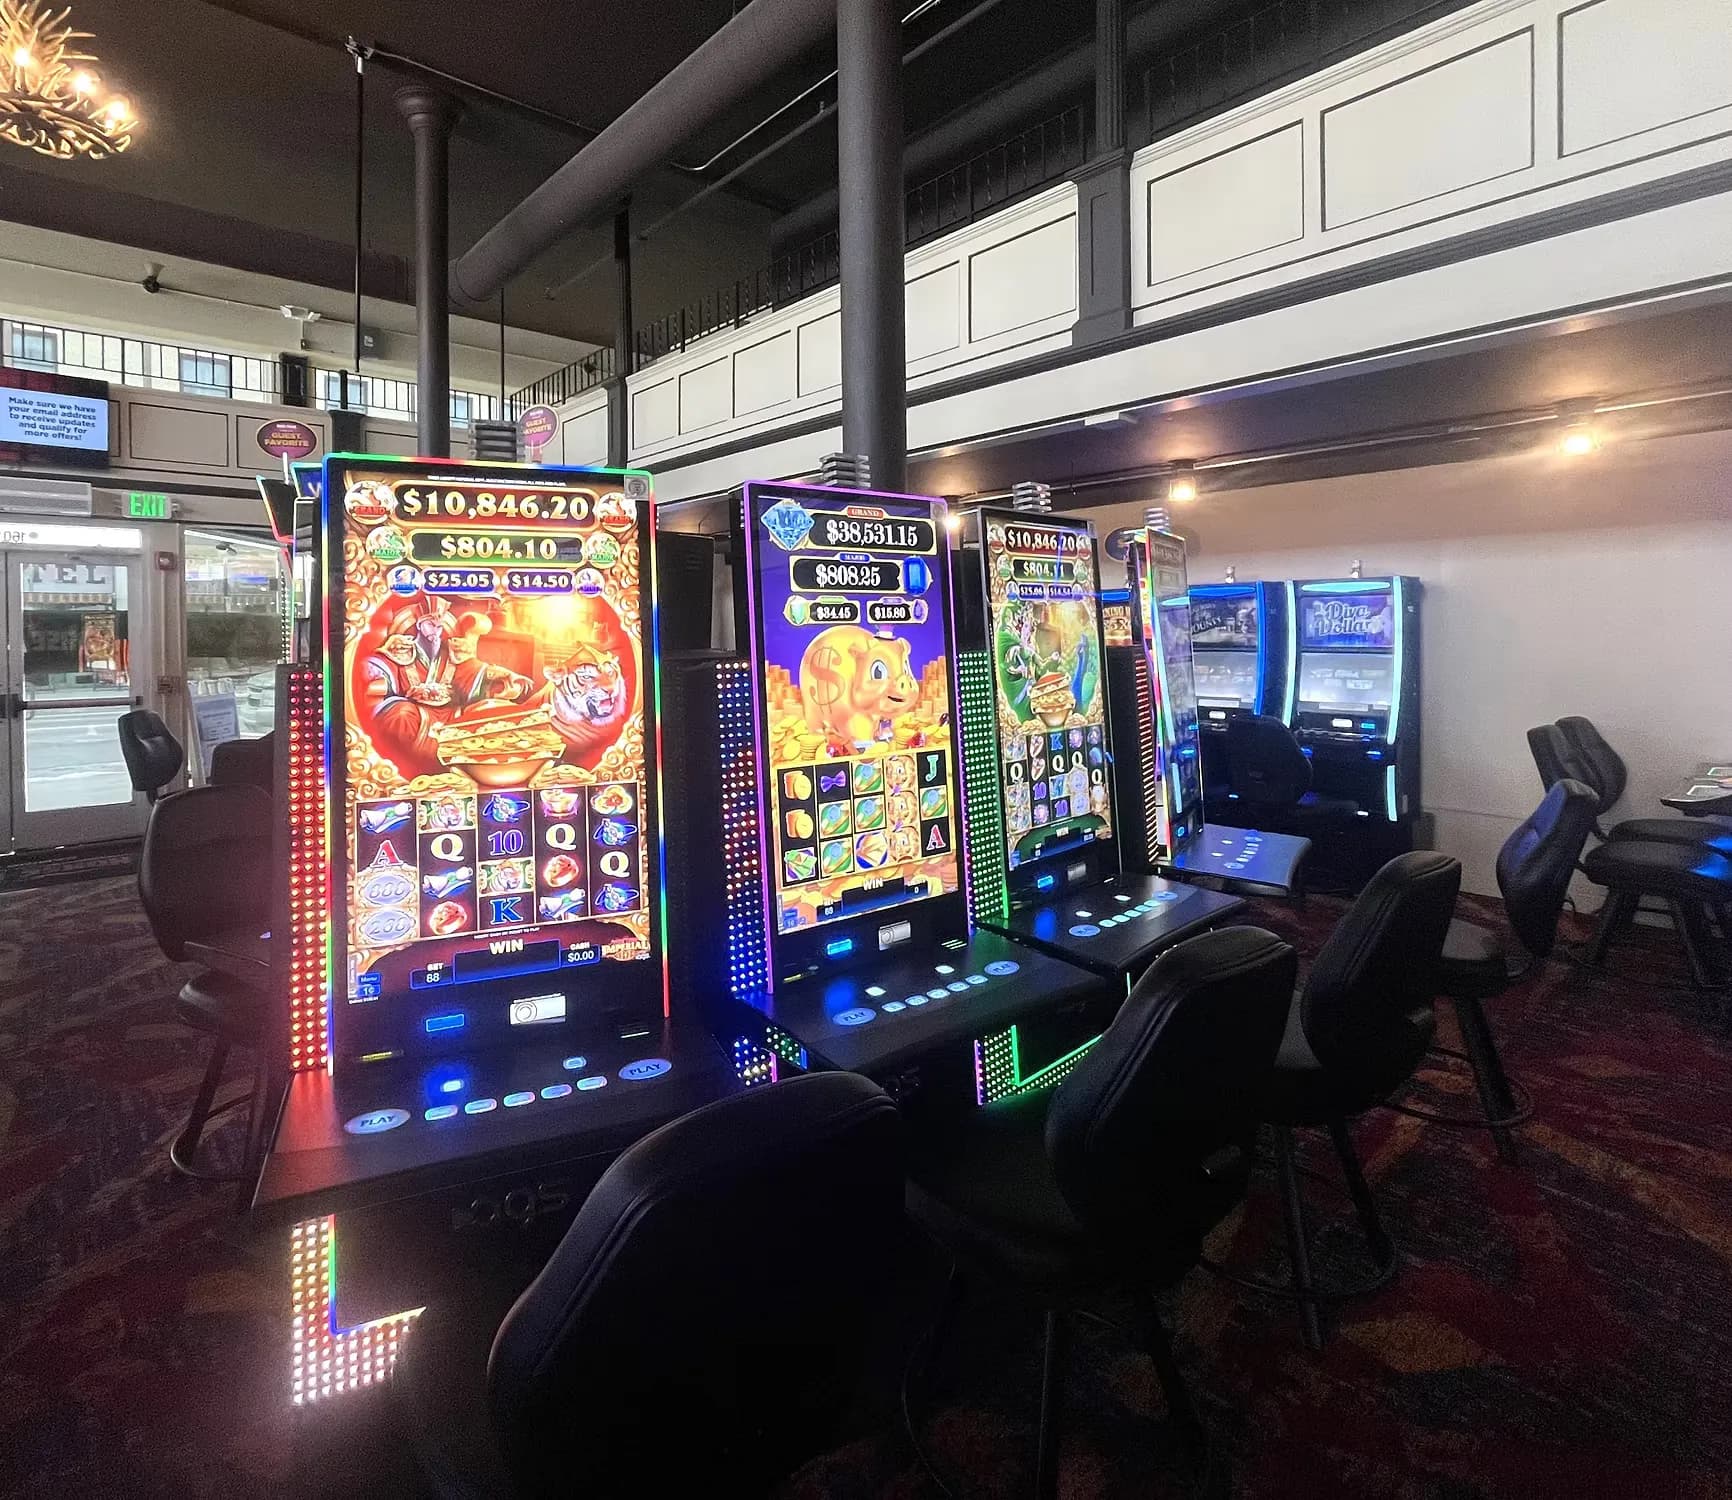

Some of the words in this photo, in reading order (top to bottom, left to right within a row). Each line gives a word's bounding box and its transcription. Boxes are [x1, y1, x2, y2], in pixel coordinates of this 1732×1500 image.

[8, 396, 34, 406] Make
[36, 400, 57, 409] sure
[74, 404, 96, 413] have
[8, 405, 30, 413] your
[32, 407, 59, 416] email
[60, 411, 97, 420] address
[9, 412, 20, 420] to
[22, 414, 57, 423] receive
[58, 418, 96, 428] updates
[19, 421, 37, 429] and
[38, 424, 72, 434] qualify
[74, 426, 88, 434] for
[24, 430, 49, 438] more
[52, 432, 82, 441] offers!
[128, 491, 167, 517] EXIT
[403, 488, 589, 520] $10,846.20
[826, 519, 918, 547] $38,531.15
[1007, 529, 1075, 552] $10,846.20
[440, 535, 557, 560] $804.10
[428, 572, 490, 588] $25.05
[512, 573, 569, 588] $14.50
[815, 563, 881, 588] $808.25
[816, 605, 851, 620] $34.45
[1325, 600, 1371, 620] Diva
[925, 755, 939, 782] J
[1052, 754, 1065, 773] Q
[487, 829, 524, 856] 10
[545, 823, 577, 850] Q
[926, 823, 946, 852] A
[372, 839, 404, 868] A
[430, 833, 465, 862] Q
[599, 850, 631, 878] Q
[863, 877, 884, 891] WIN
[488, 896, 526, 926] K
[489, 938, 524, 955] WIN
[567, 950, 595, 963] $0.00
[426, 973, 440, 983] 88
[629, 1062, 661, 1076] PLAY
[359, 1114, 396, 1127] PLAY
